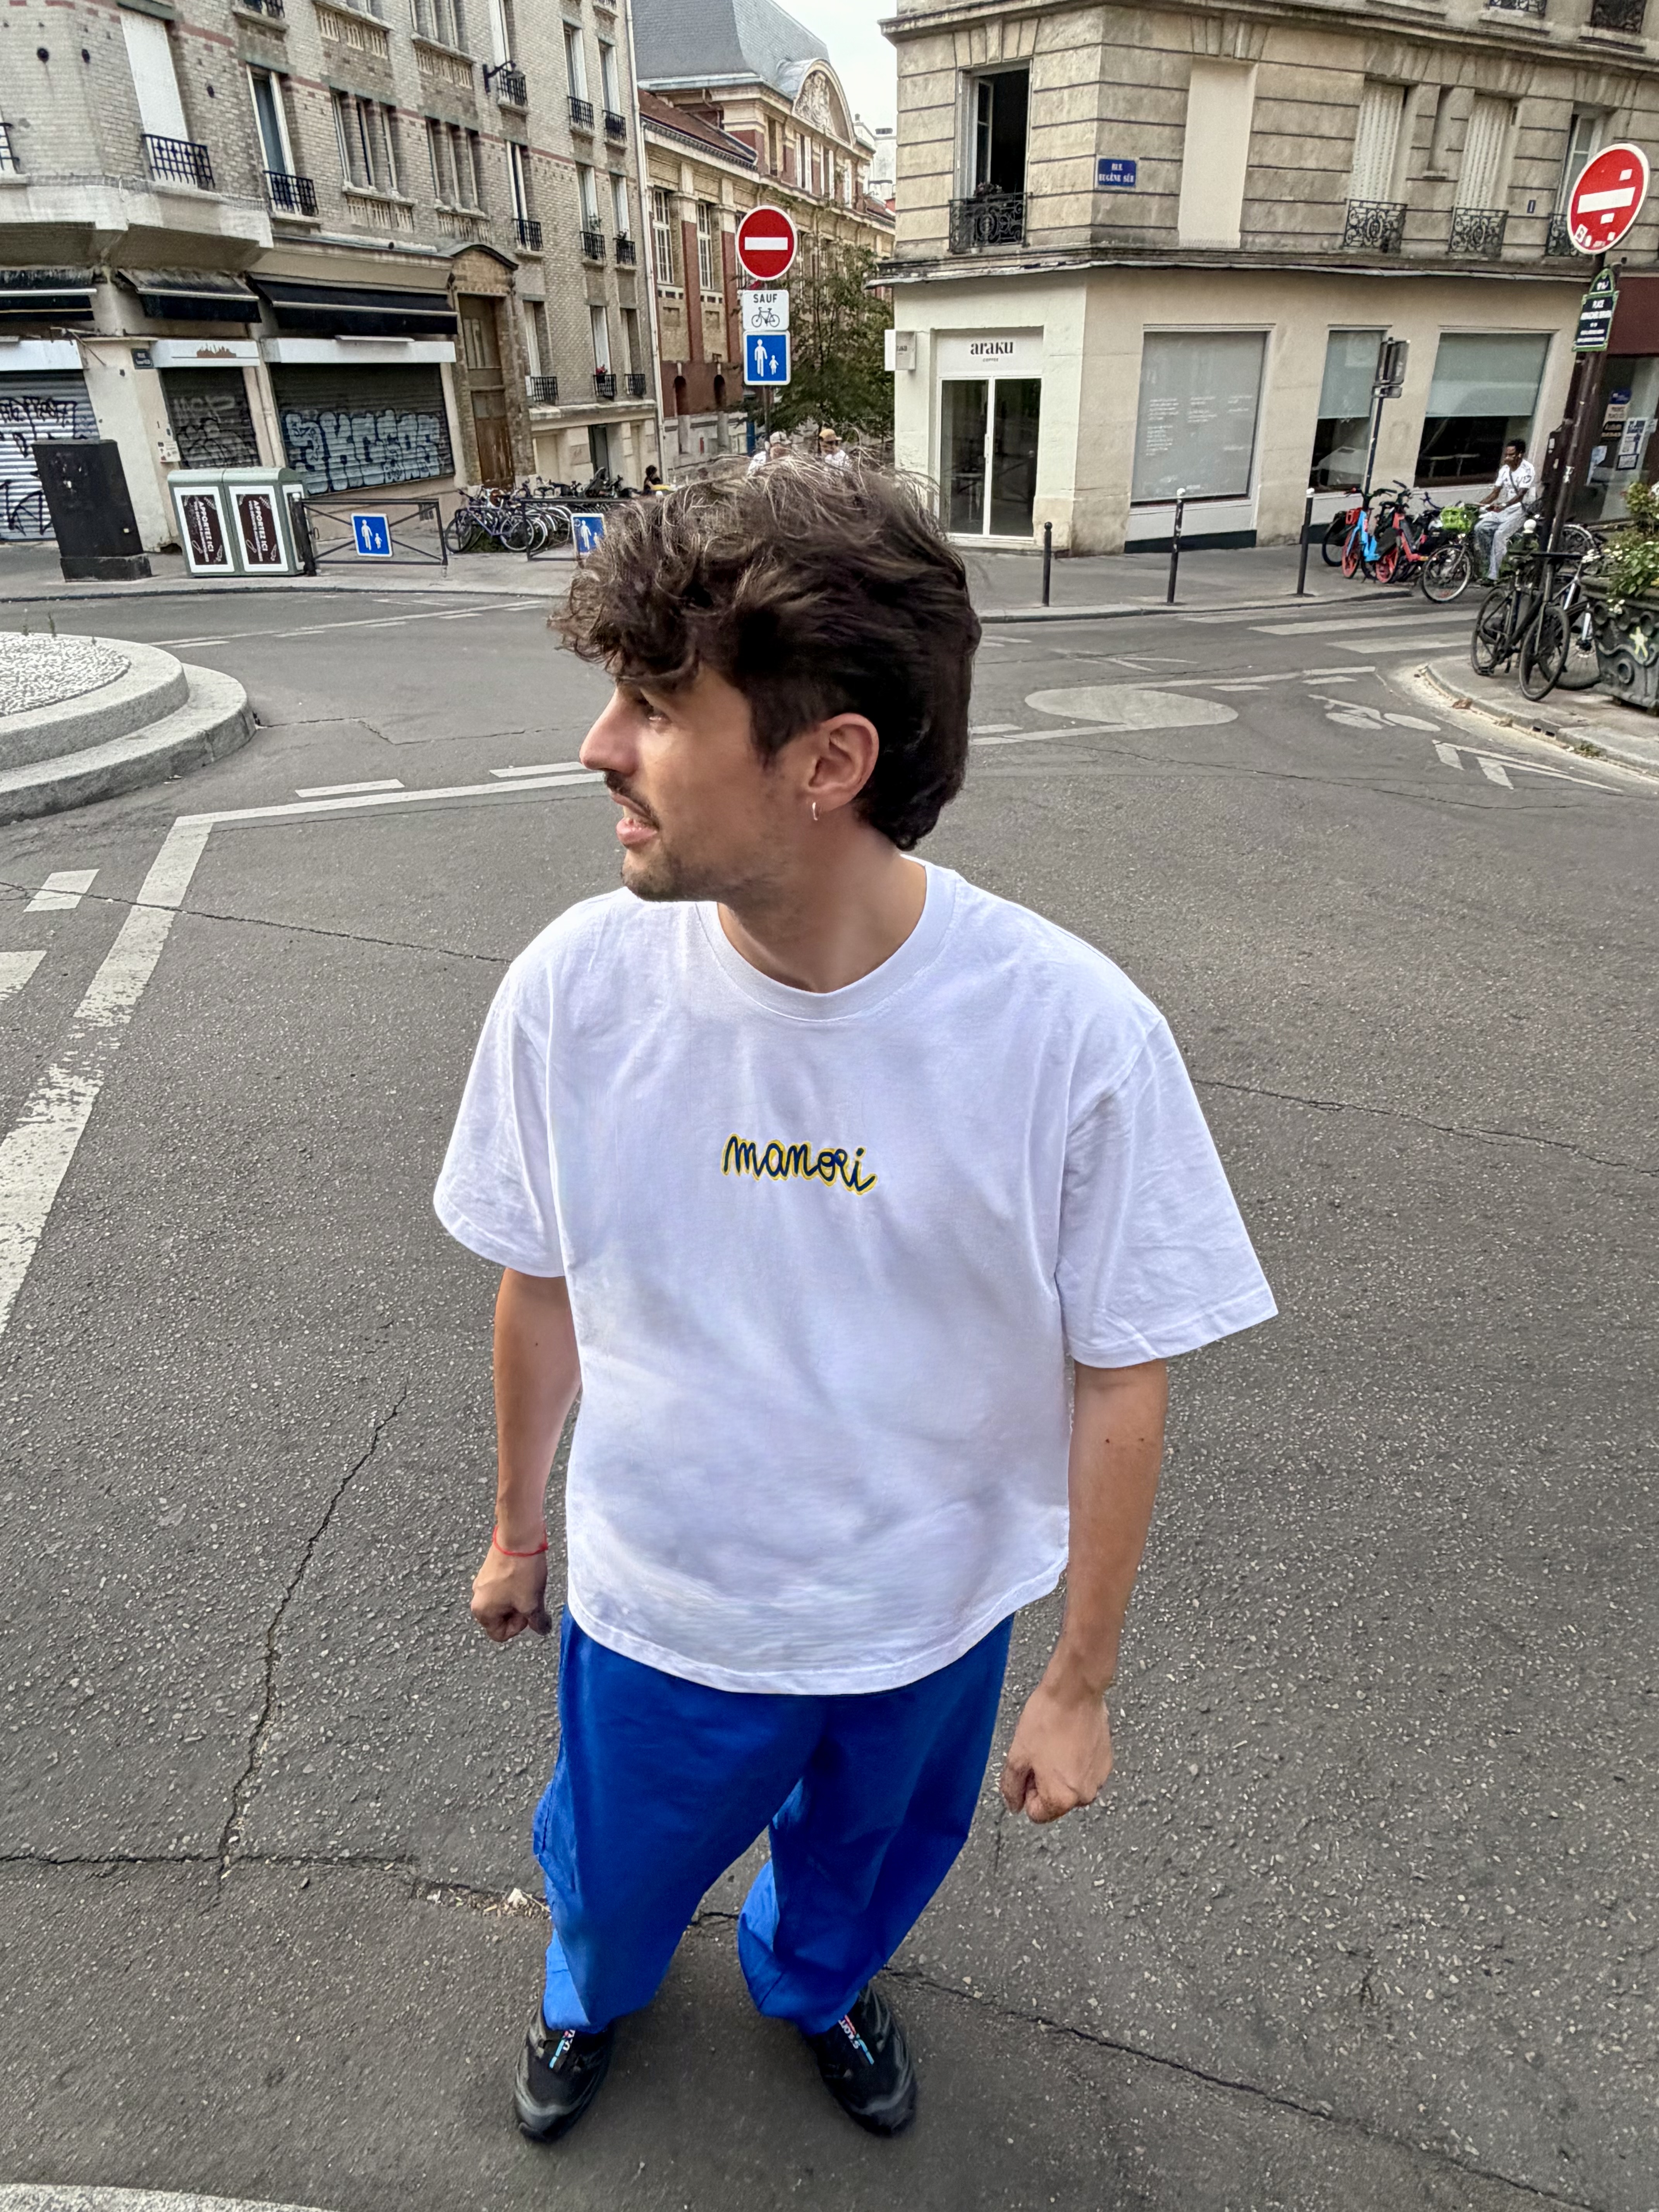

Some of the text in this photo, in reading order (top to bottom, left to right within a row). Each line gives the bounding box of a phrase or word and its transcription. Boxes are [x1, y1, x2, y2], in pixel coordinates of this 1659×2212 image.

[753, 294, 777, 303] SAUF
[970, 342, 1013, 355] araku
[198, 501, 212, 540] APPORTEZ
[253, 500, 266, 539] APPORTEZ
